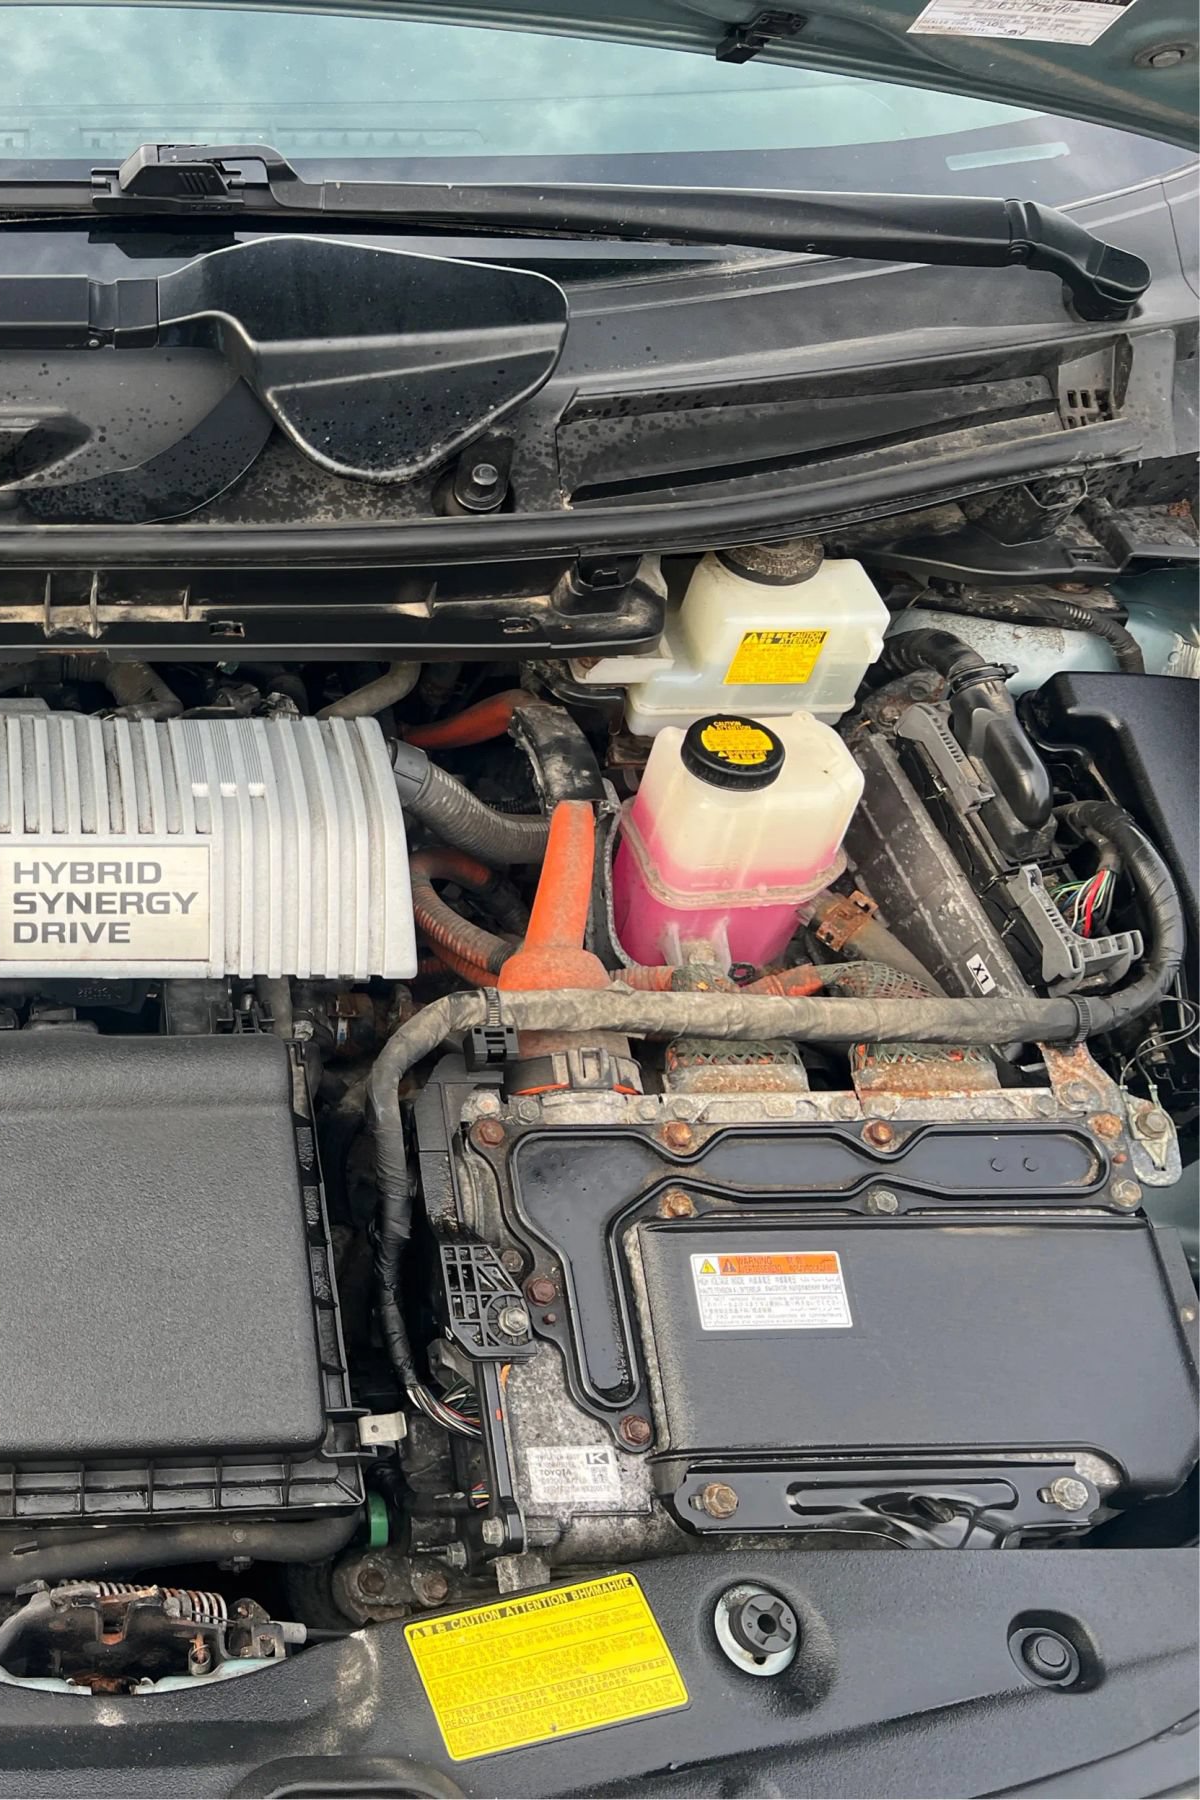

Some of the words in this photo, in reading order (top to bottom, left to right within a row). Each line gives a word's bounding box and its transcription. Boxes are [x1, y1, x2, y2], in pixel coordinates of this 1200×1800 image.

[13, 861, 162, 885] HYBRID
[13, 891, 199, 915] SYNERGY
[13, 921, 132, 944] DRIVE
[540, 1468, 572, 1477] TOYOTA
[449, 1609, 502, 1631] CAUTION
[505, 1594, 568, 1617] ATTENTION
[571, 1578, 633, 1601] ВНИМАНИЕ
